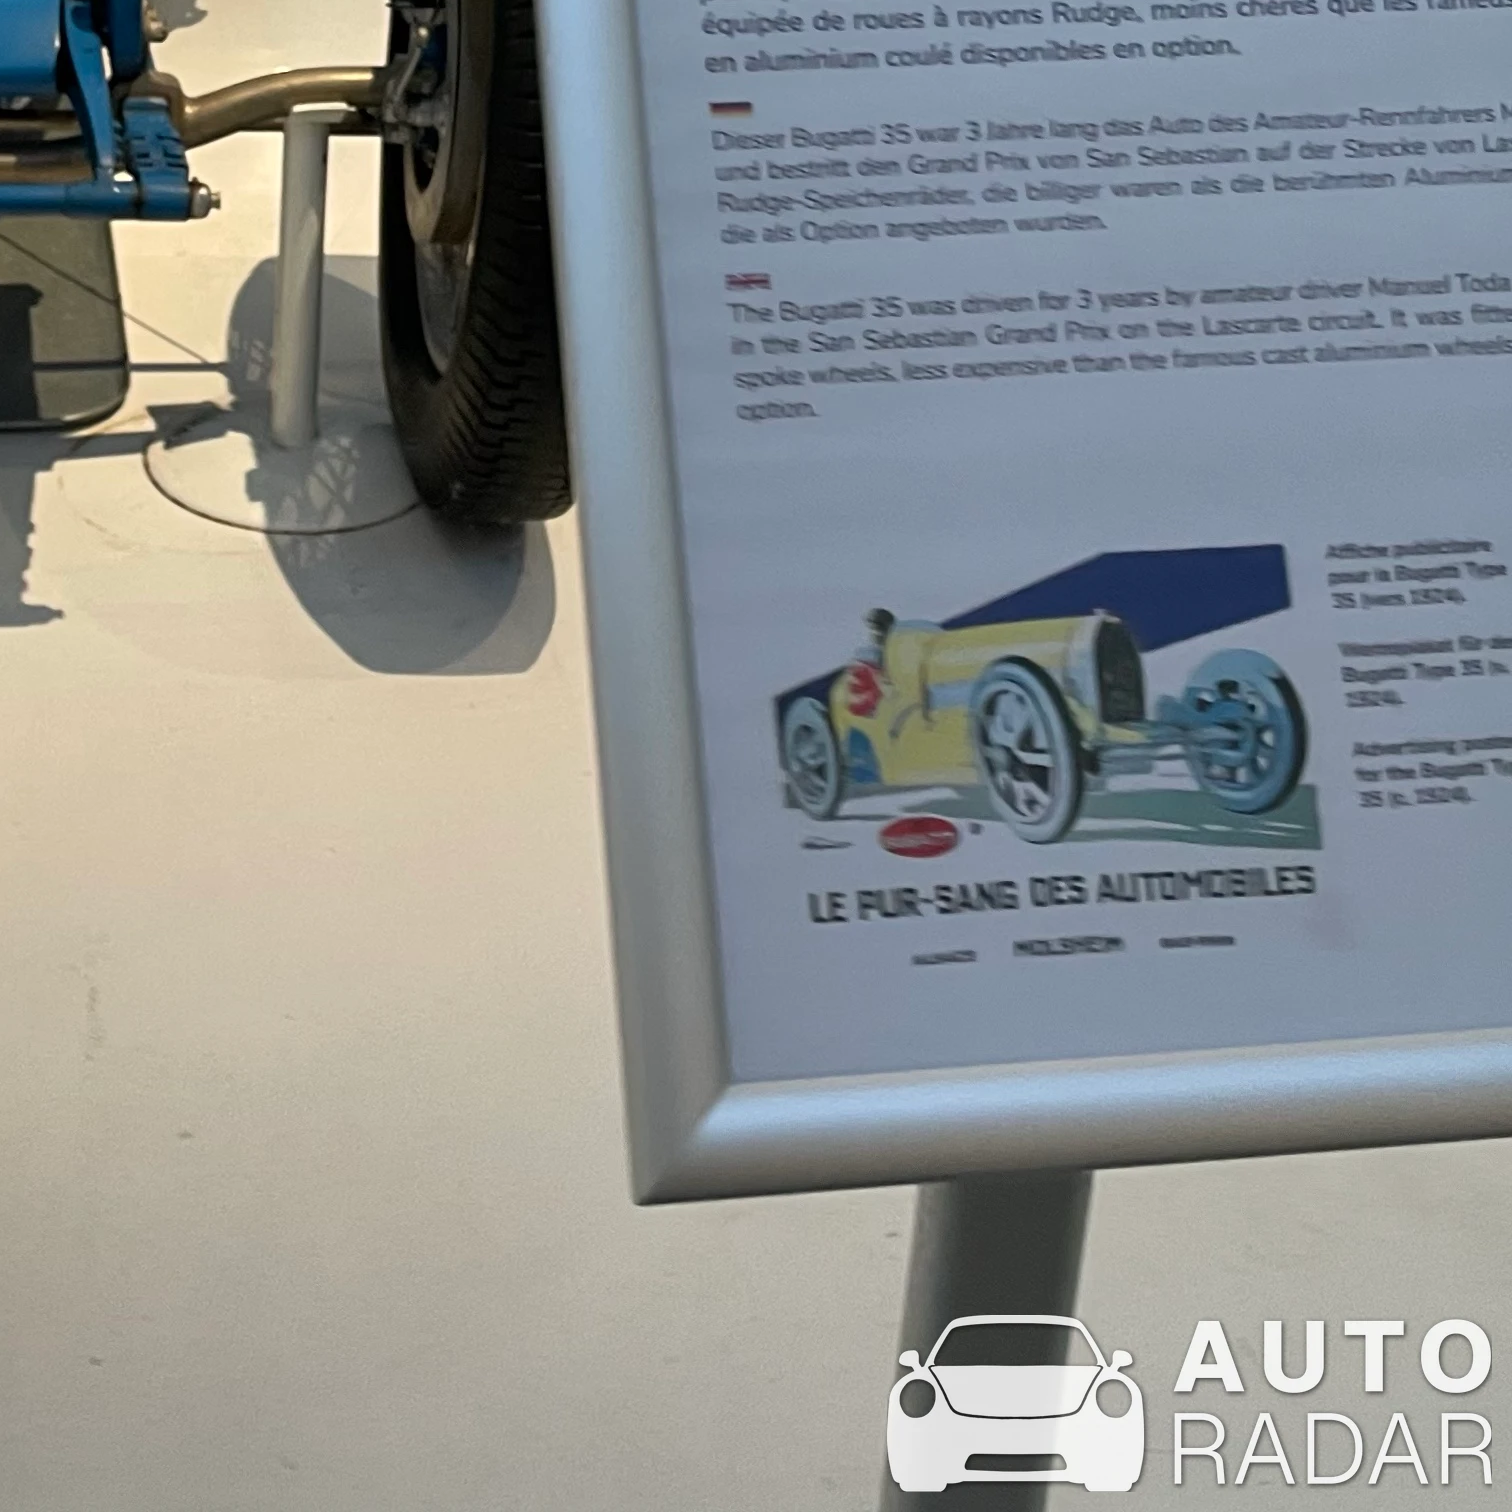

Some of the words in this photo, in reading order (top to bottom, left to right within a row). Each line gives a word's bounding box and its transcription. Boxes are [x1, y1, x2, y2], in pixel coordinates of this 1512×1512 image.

[701, 11, 804, 37] équipée
[813, 10, 844, 31] de
[853, 11, 925, 29] roues
[933, 5, 948, 27] à
[957, 6, 1043, 29] rayons
[704, 53, 737, 73] en
[744, 47, 879, 71] aluminium
[885, 43, 953, 66] coulé
[960, 40, 1106, 65] disponibles
[1113, 41, 1145, 58] en
[880, 123, 912, 144] 35
[965, 121, 982, 141] 3
[907, 154, 978, 175] Grand
[1087, 147, 1131, 168] San
[727, 302, 774, 324] The
[870, 297, 904, 318] 35
[1076, 289, 1093, 309] 3
[808, 332, 856, 352] San
[863, 327, 978, 350] Sebastian
[985, 323, 1057, 345] Grand
[901, 360, 949, 381] less
[807, 892, 848, 924] LE
[858, 880, 1019, 921] PUR-SANG
[1029, 874, 1087, 907] DES
[1096, 865, 1316, 903] AUTOMOBILES
